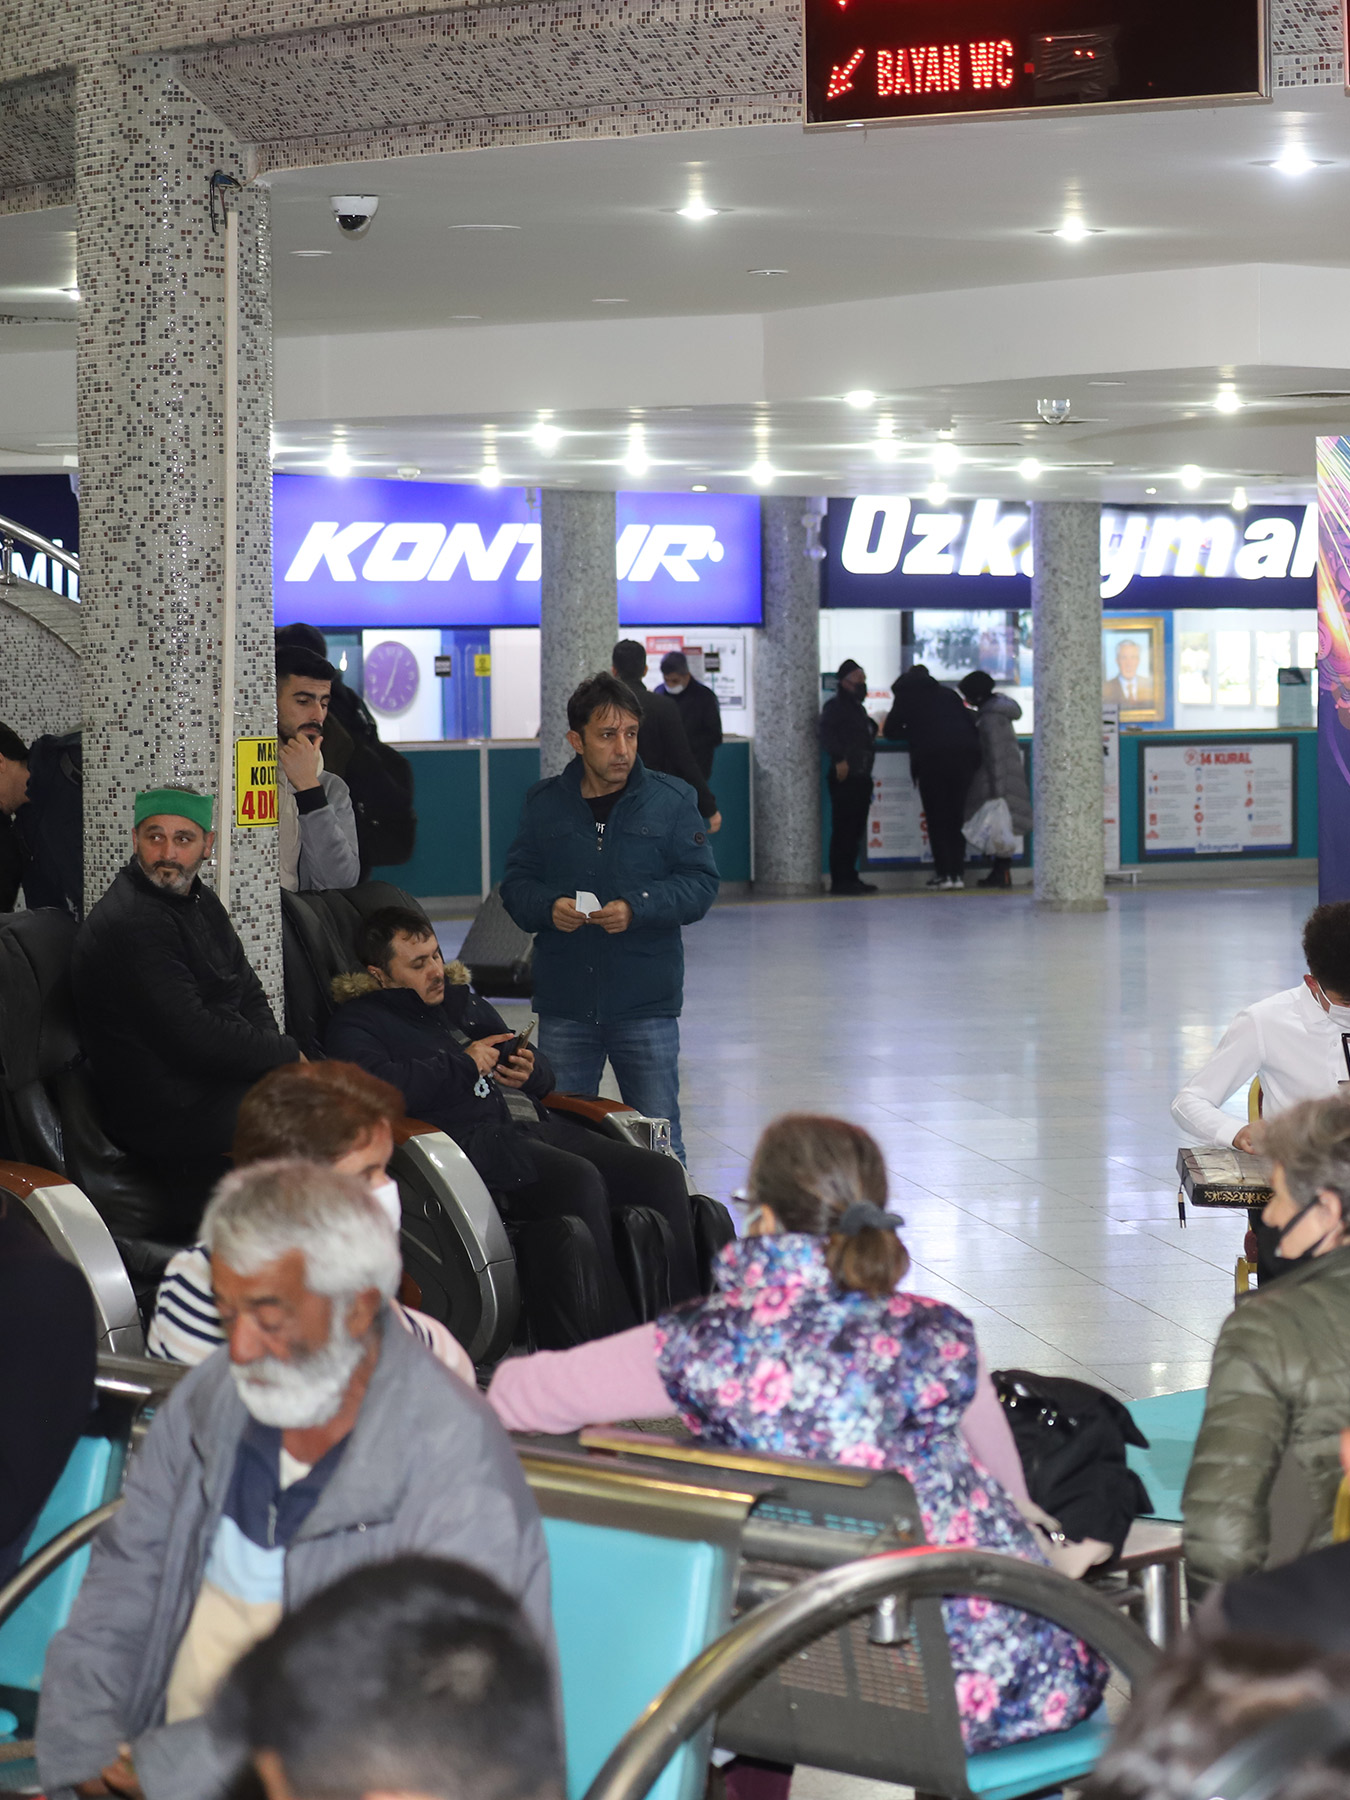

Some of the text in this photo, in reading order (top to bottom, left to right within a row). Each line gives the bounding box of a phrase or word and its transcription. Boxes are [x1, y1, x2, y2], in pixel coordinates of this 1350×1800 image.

[877, 39, 1014, 96] BAYAN WC
[250, 765, 277, 786] KOLT
[241, 789, 277, 820] 4 DK
